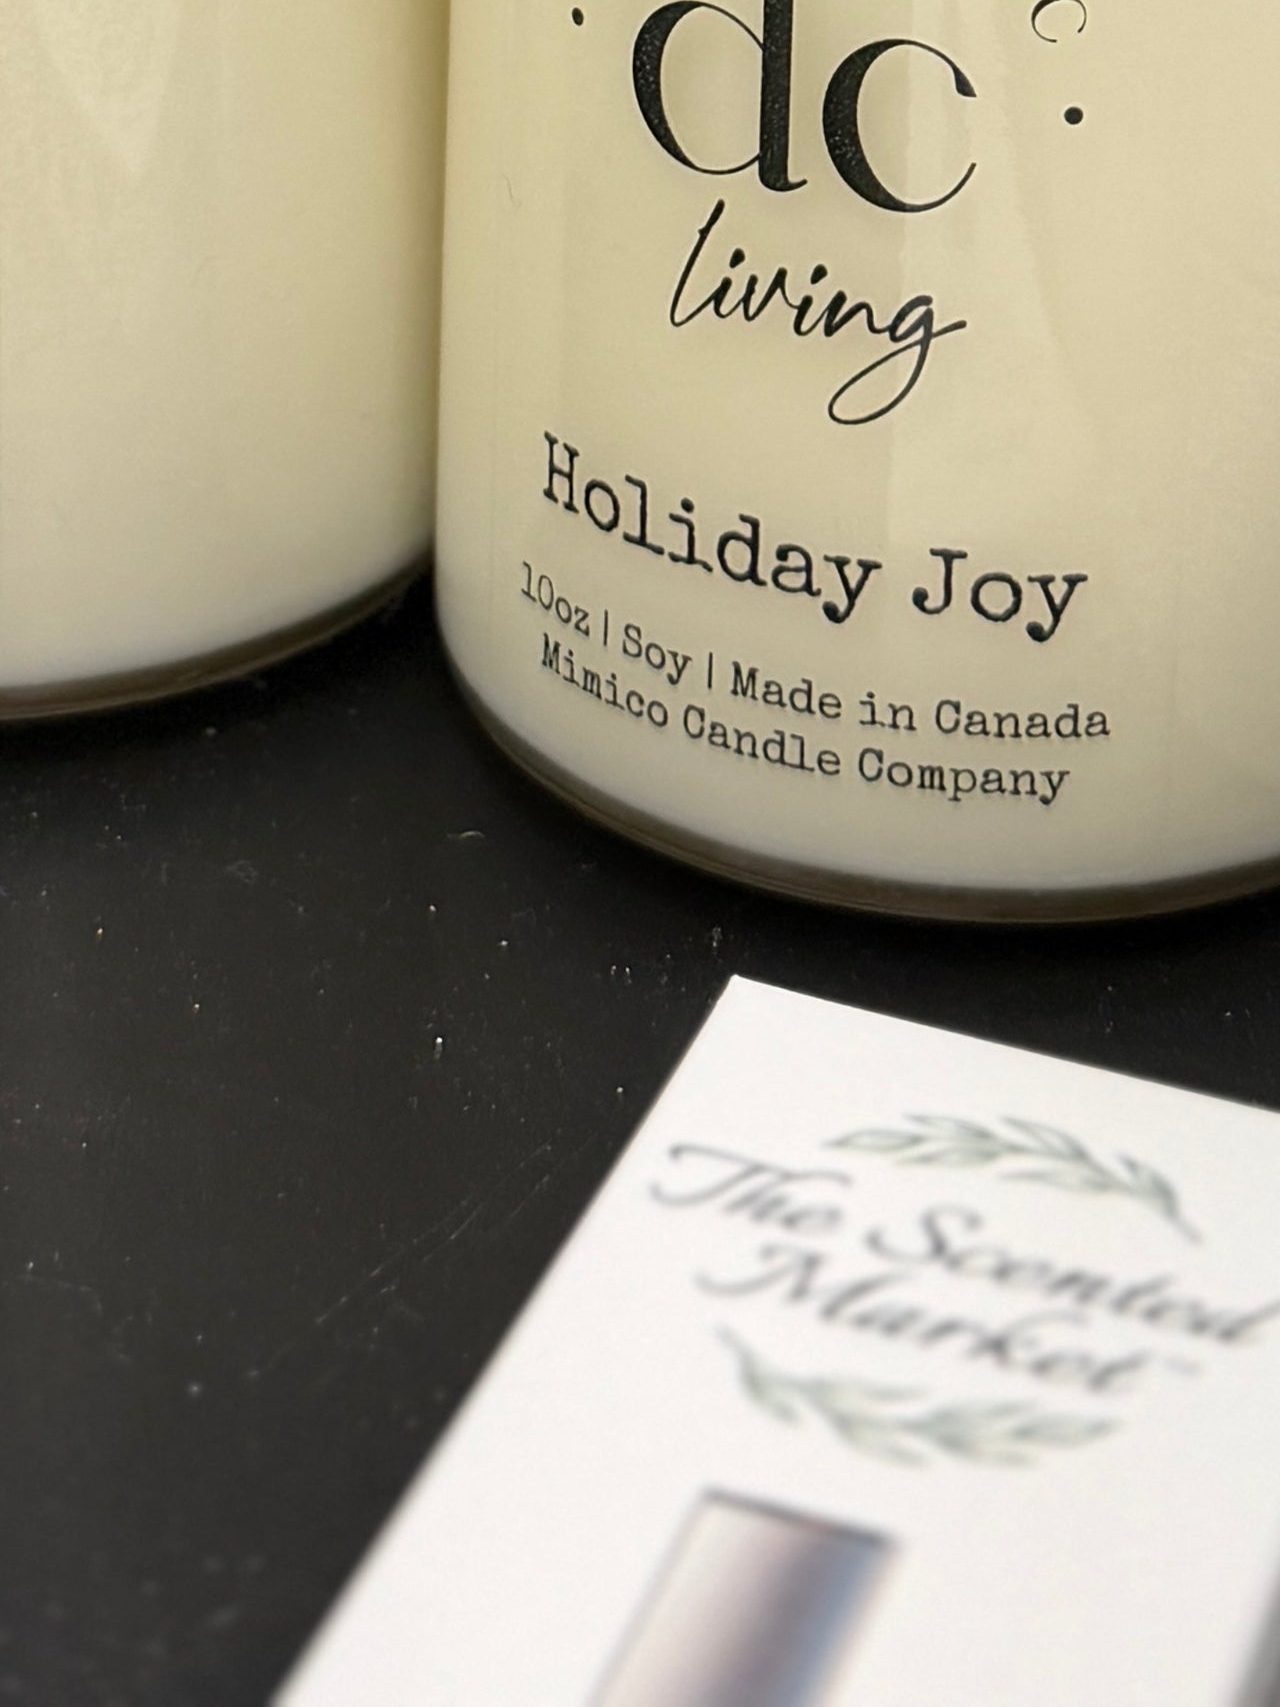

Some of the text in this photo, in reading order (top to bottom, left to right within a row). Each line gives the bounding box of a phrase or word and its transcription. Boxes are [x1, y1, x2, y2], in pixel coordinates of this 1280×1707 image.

[669, 198, 968, 426] living
[540, 430, 1089, 645] Holiday Joy
[520, 560, 591, 638] 10oz
[621, 622, 693, 687] Soy
[729, 660, 843, 720] Made
[858, 690, 918, 733] in
[934, 699, 1111, 741] Canada
[540, 631, 1071, 807] Mimico Candle Company
[648, 1142, 852, 1236] The
